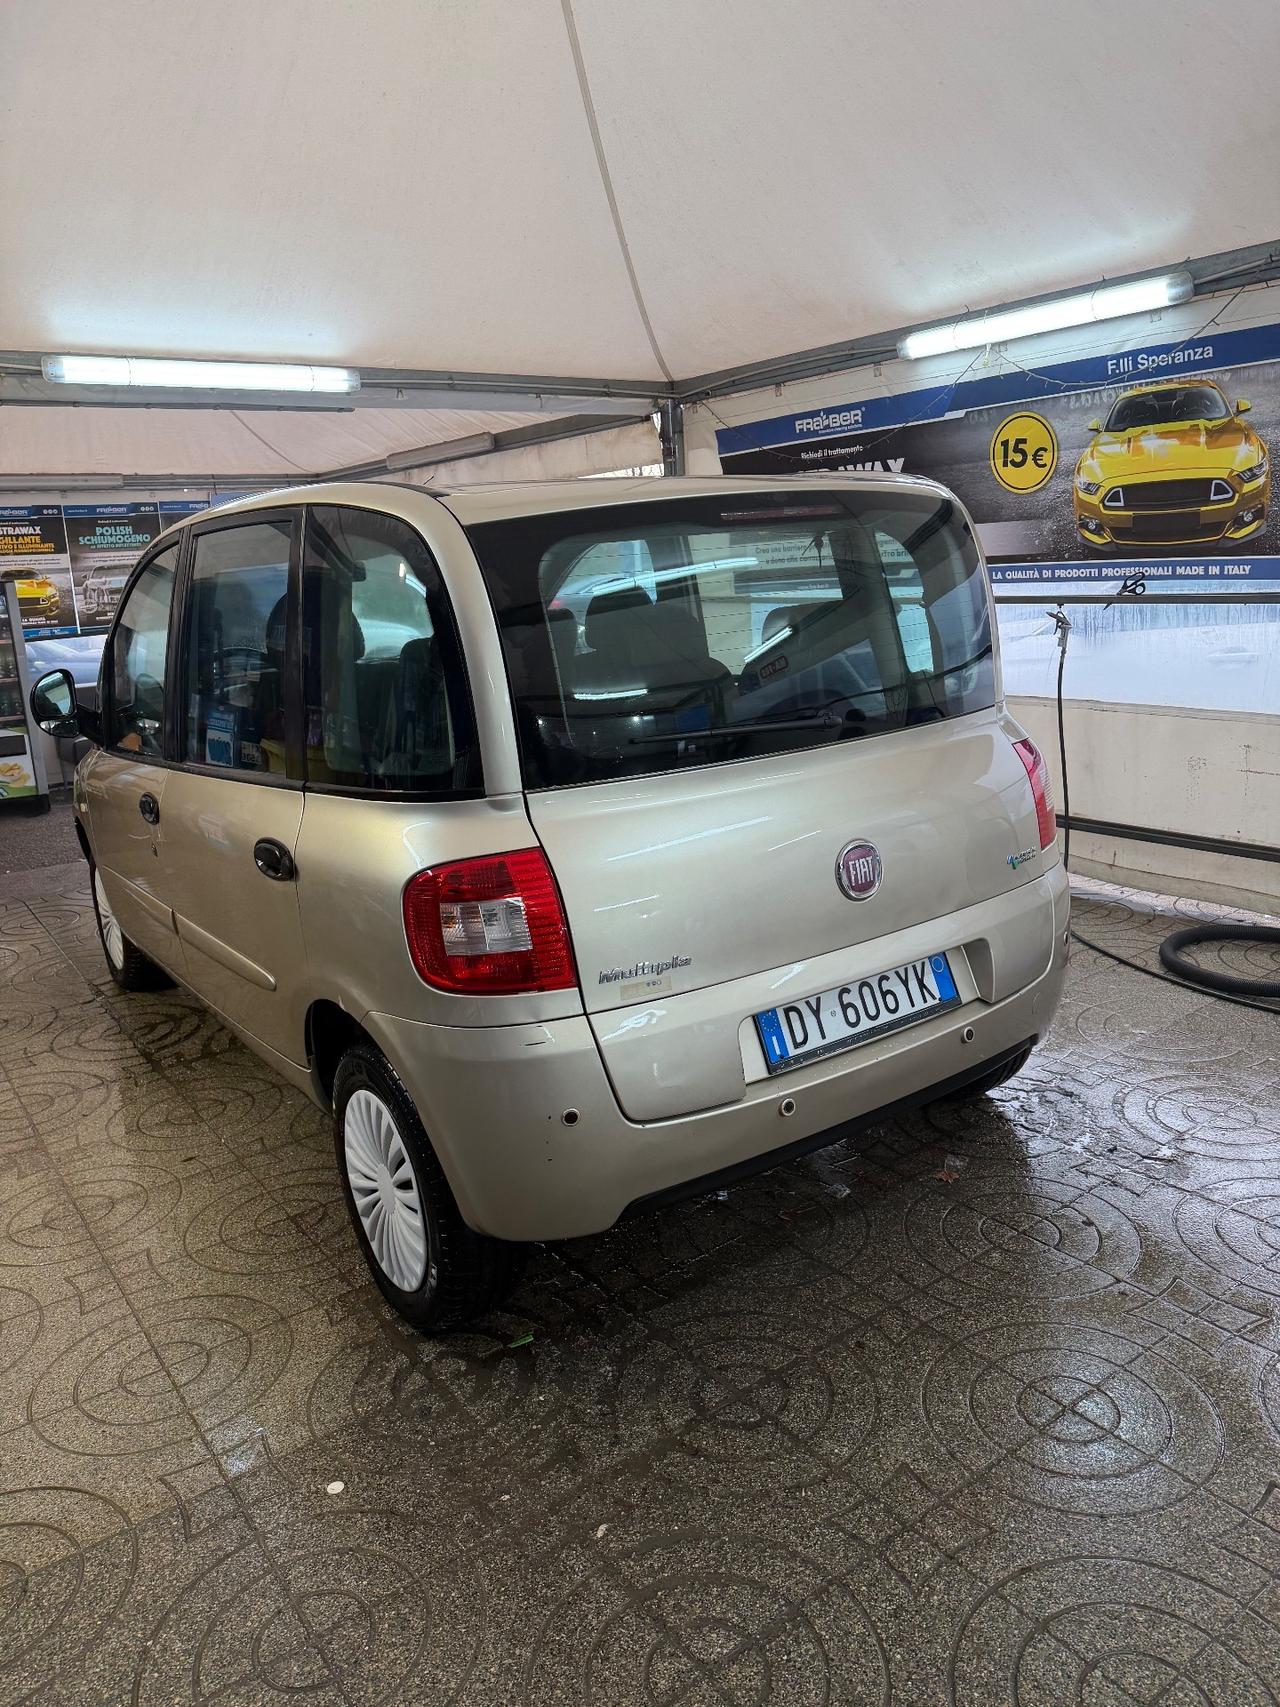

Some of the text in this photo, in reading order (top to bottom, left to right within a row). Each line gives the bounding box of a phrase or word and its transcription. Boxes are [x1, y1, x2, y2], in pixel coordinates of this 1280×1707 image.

[1137, 351, 1213, 372] Speranza
[828, 445, 863, 456] trattamento
[96, 526, 133, 536] POLISH
[79, 534, 150, 545] SCHIUMOGENO
[1005, 568, 1039, 579] QUALITÀ
[1042, 570, 1051, 578] DI
[1054, 569, 1098, 578] PRODOTTI
[1101, 566, 1172, 577] PROFESSIONALI
[1175, 566, 1204, 576] MADE
[1207, 566, 1219, 575] IN
[1223, 565, 1251, 575] ITALY
[849, 855, 877, 886] FIAT
[783, 996, 827, 1049] DY
